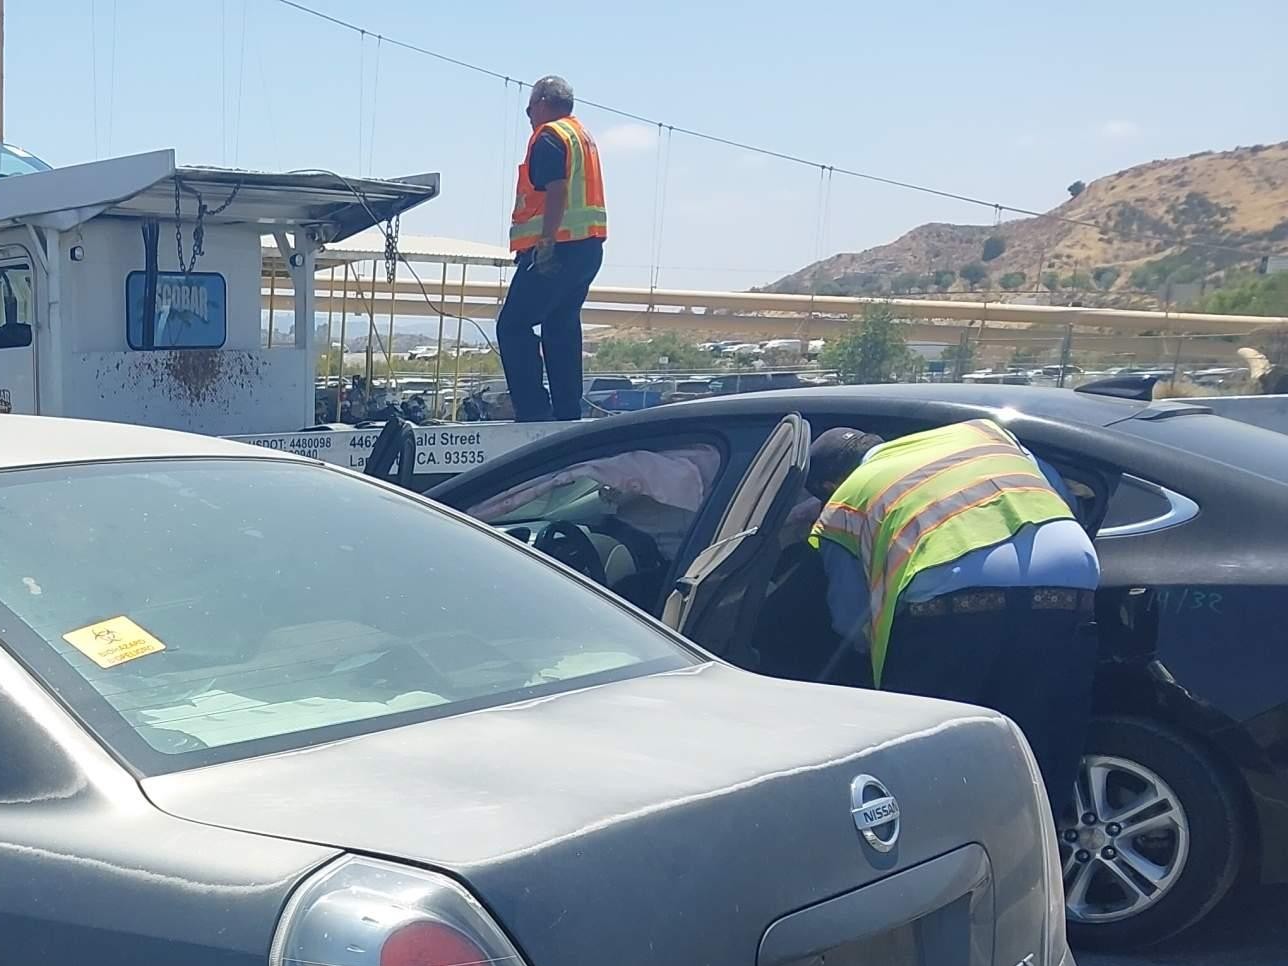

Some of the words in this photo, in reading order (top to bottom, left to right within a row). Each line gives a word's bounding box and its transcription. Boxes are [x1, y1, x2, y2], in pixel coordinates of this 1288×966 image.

[155, 283, 209, 321] SCOBAR
[290, 437, 332, 449] 4480098
[440, 432, 481, 446] Street
[417, 451, 440, 465] CA.
[444, 450, 485, 465] 93535
